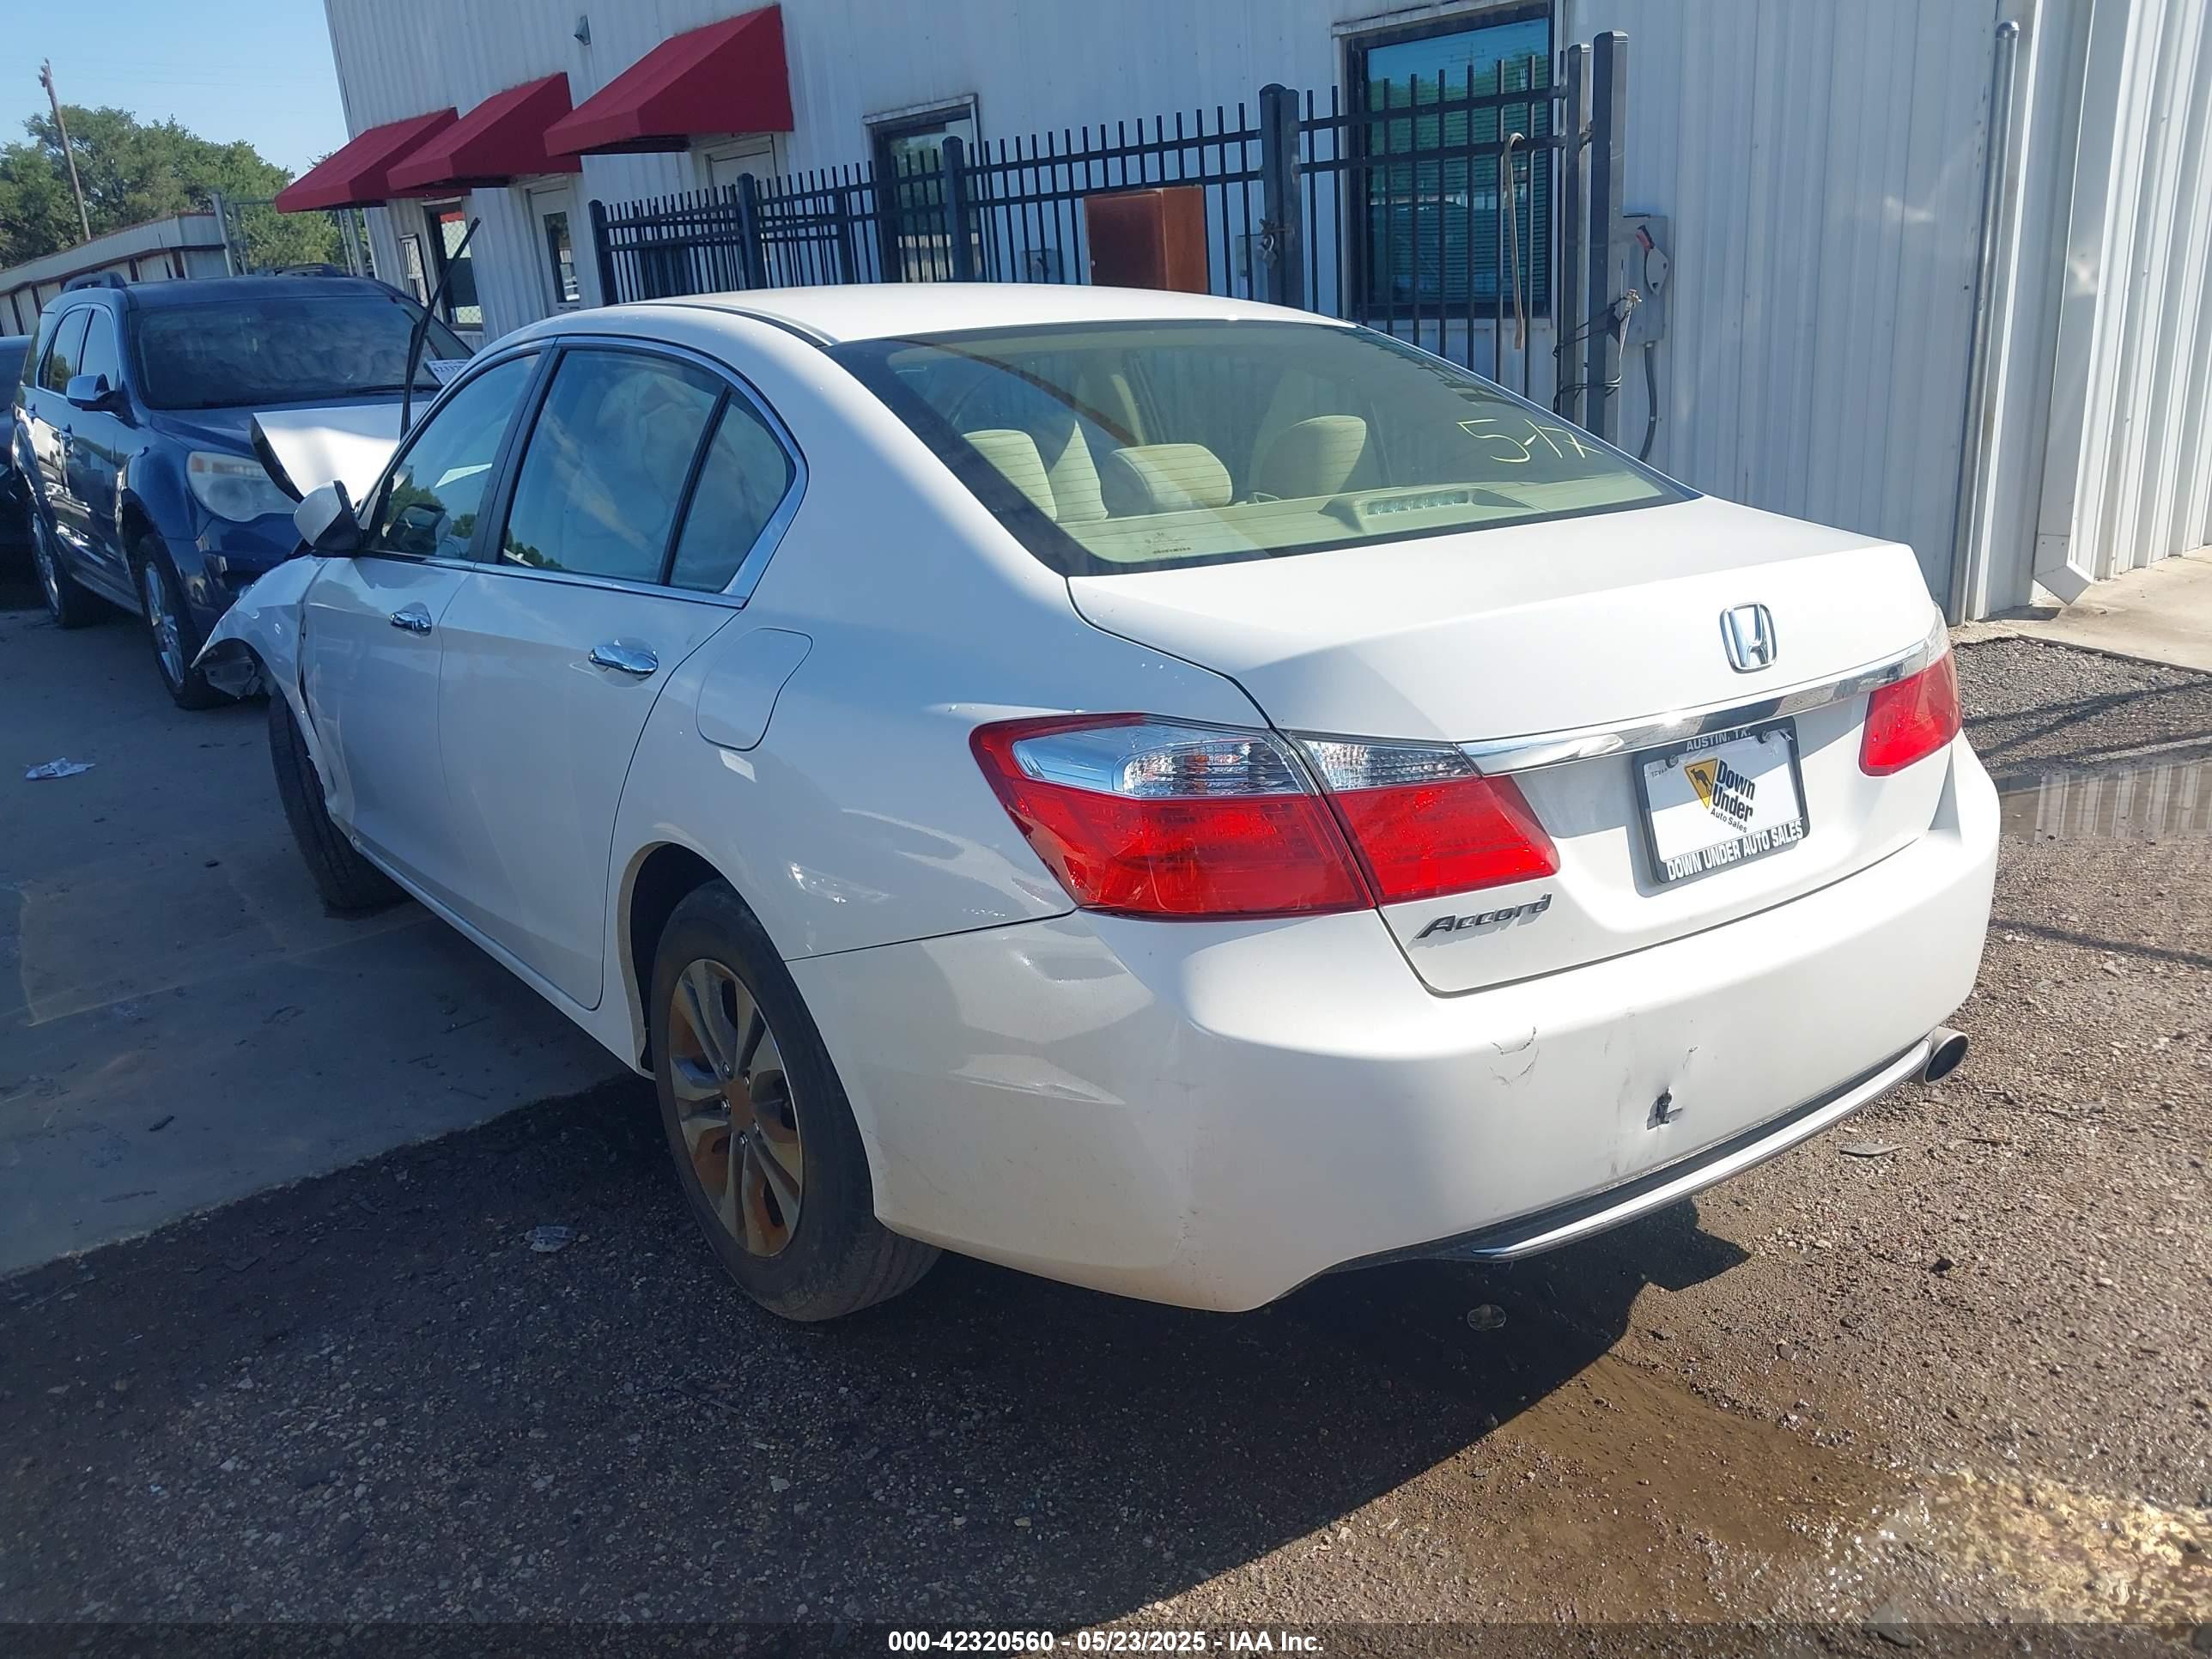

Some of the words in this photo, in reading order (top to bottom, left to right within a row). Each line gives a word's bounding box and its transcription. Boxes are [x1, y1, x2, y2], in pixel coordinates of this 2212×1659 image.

[1686, 732, 1730, 752] AUSTIN,
[1717, 760, 1756, 801] Down
[1711, 808, 1728, 822] Auto
[1728, 817, 1747, 833] Sales
[1712, 783, 1753, 823] Under
[1666, 852, 1703, 881] DOWN
[1703, 839, 1741, 869] UNDER
[1742, 830, 1771, 856] AUTO
[1771, 819, 1803, 847] SALES
[1415, 893, 1553, 939] Accord
